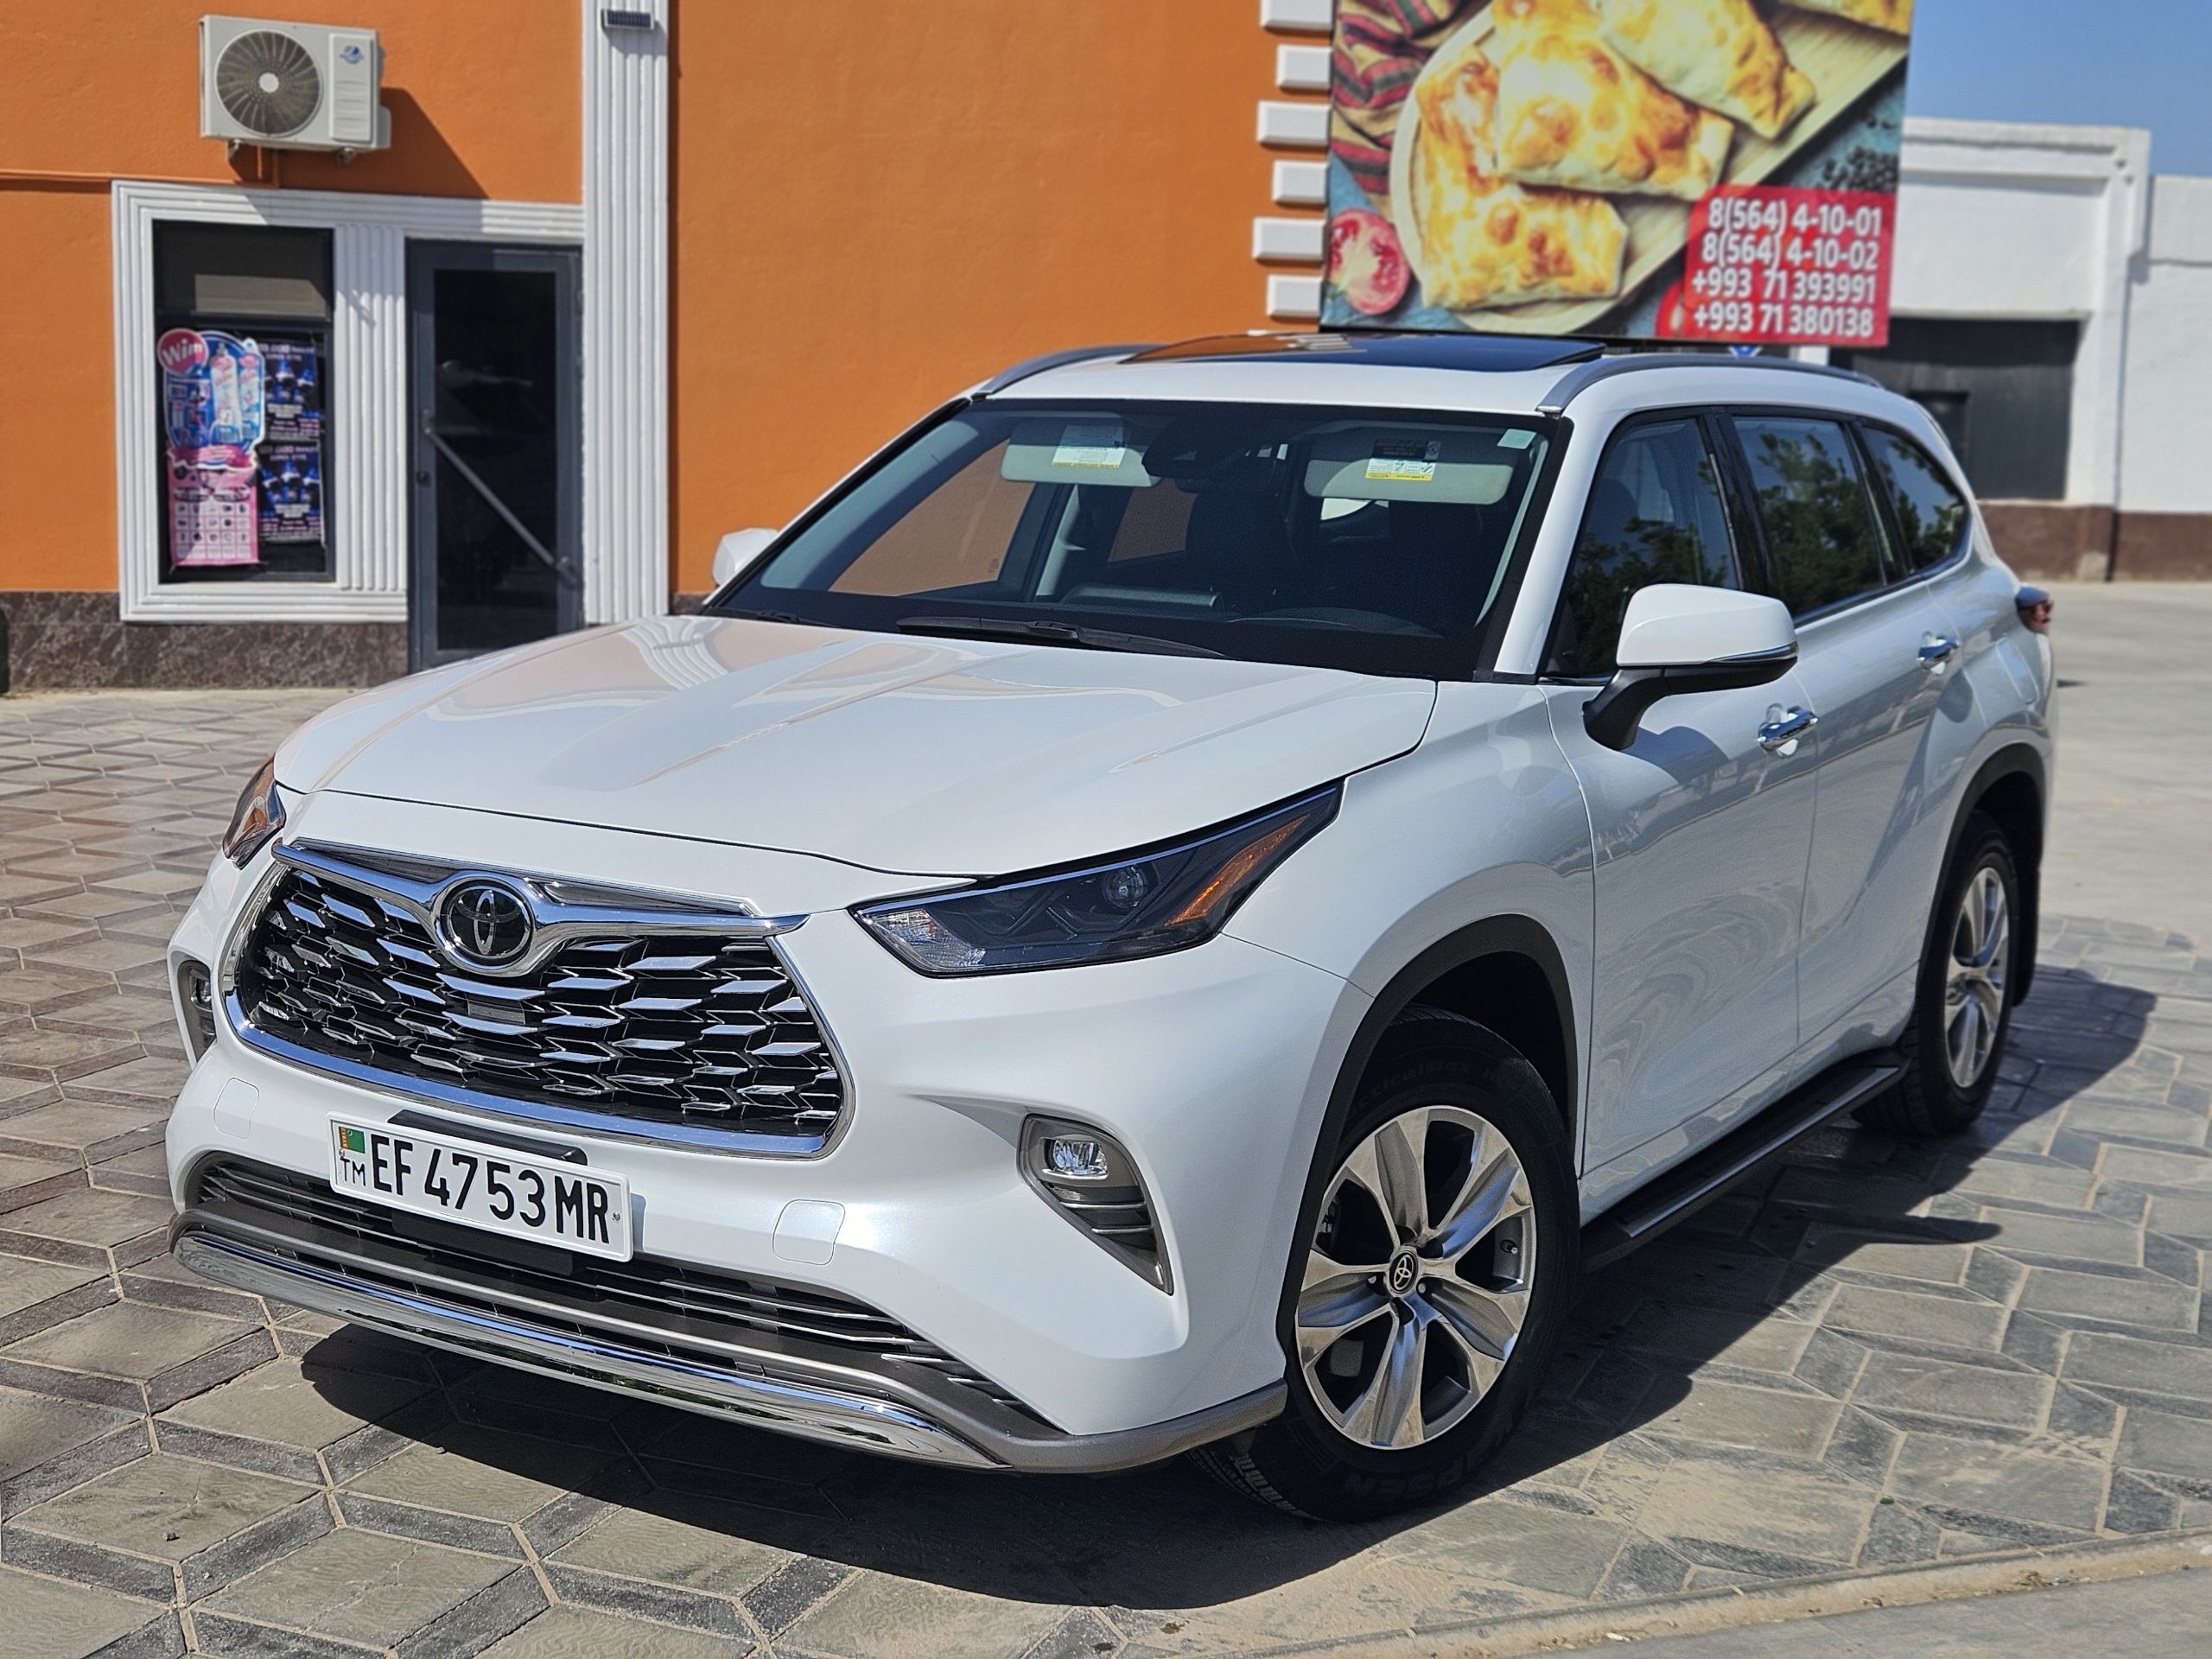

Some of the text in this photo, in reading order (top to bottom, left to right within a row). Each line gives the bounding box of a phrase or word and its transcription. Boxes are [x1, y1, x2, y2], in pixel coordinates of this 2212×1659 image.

[1707, 197, 1882, 238] 8(564) 4-10-01
[1701, 231, 1879, 271] 8(564) 4-10-02
[1691, 266, 1877, 304] +993 71 393991
[1694, 301, 1874, 338] +993 71 380138
[340, 1156, 366, 1187] TM
